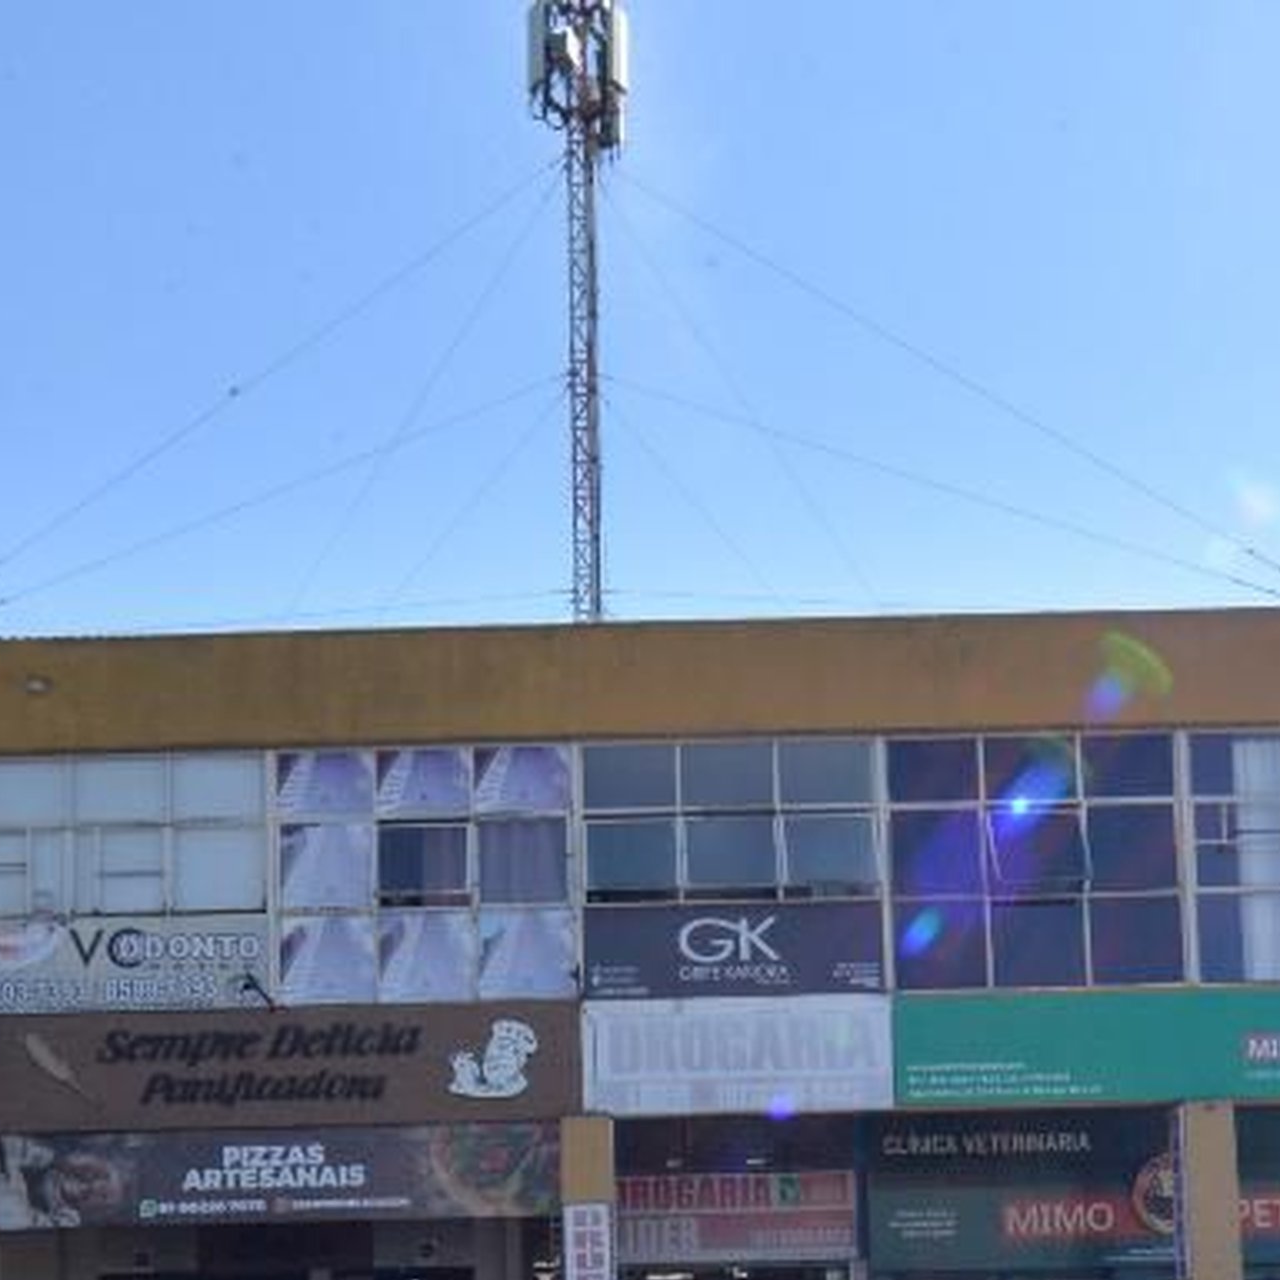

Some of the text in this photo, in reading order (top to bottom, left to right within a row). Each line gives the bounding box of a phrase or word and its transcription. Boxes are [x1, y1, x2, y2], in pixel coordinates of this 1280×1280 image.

[680, 915, 780, 963] GK
[222, 1145, 325, 1167] PIZZAS
[181, 1164, 365, 1191] ARTESANAIS
[1006, 1202, 1115, 1234] MIMO
